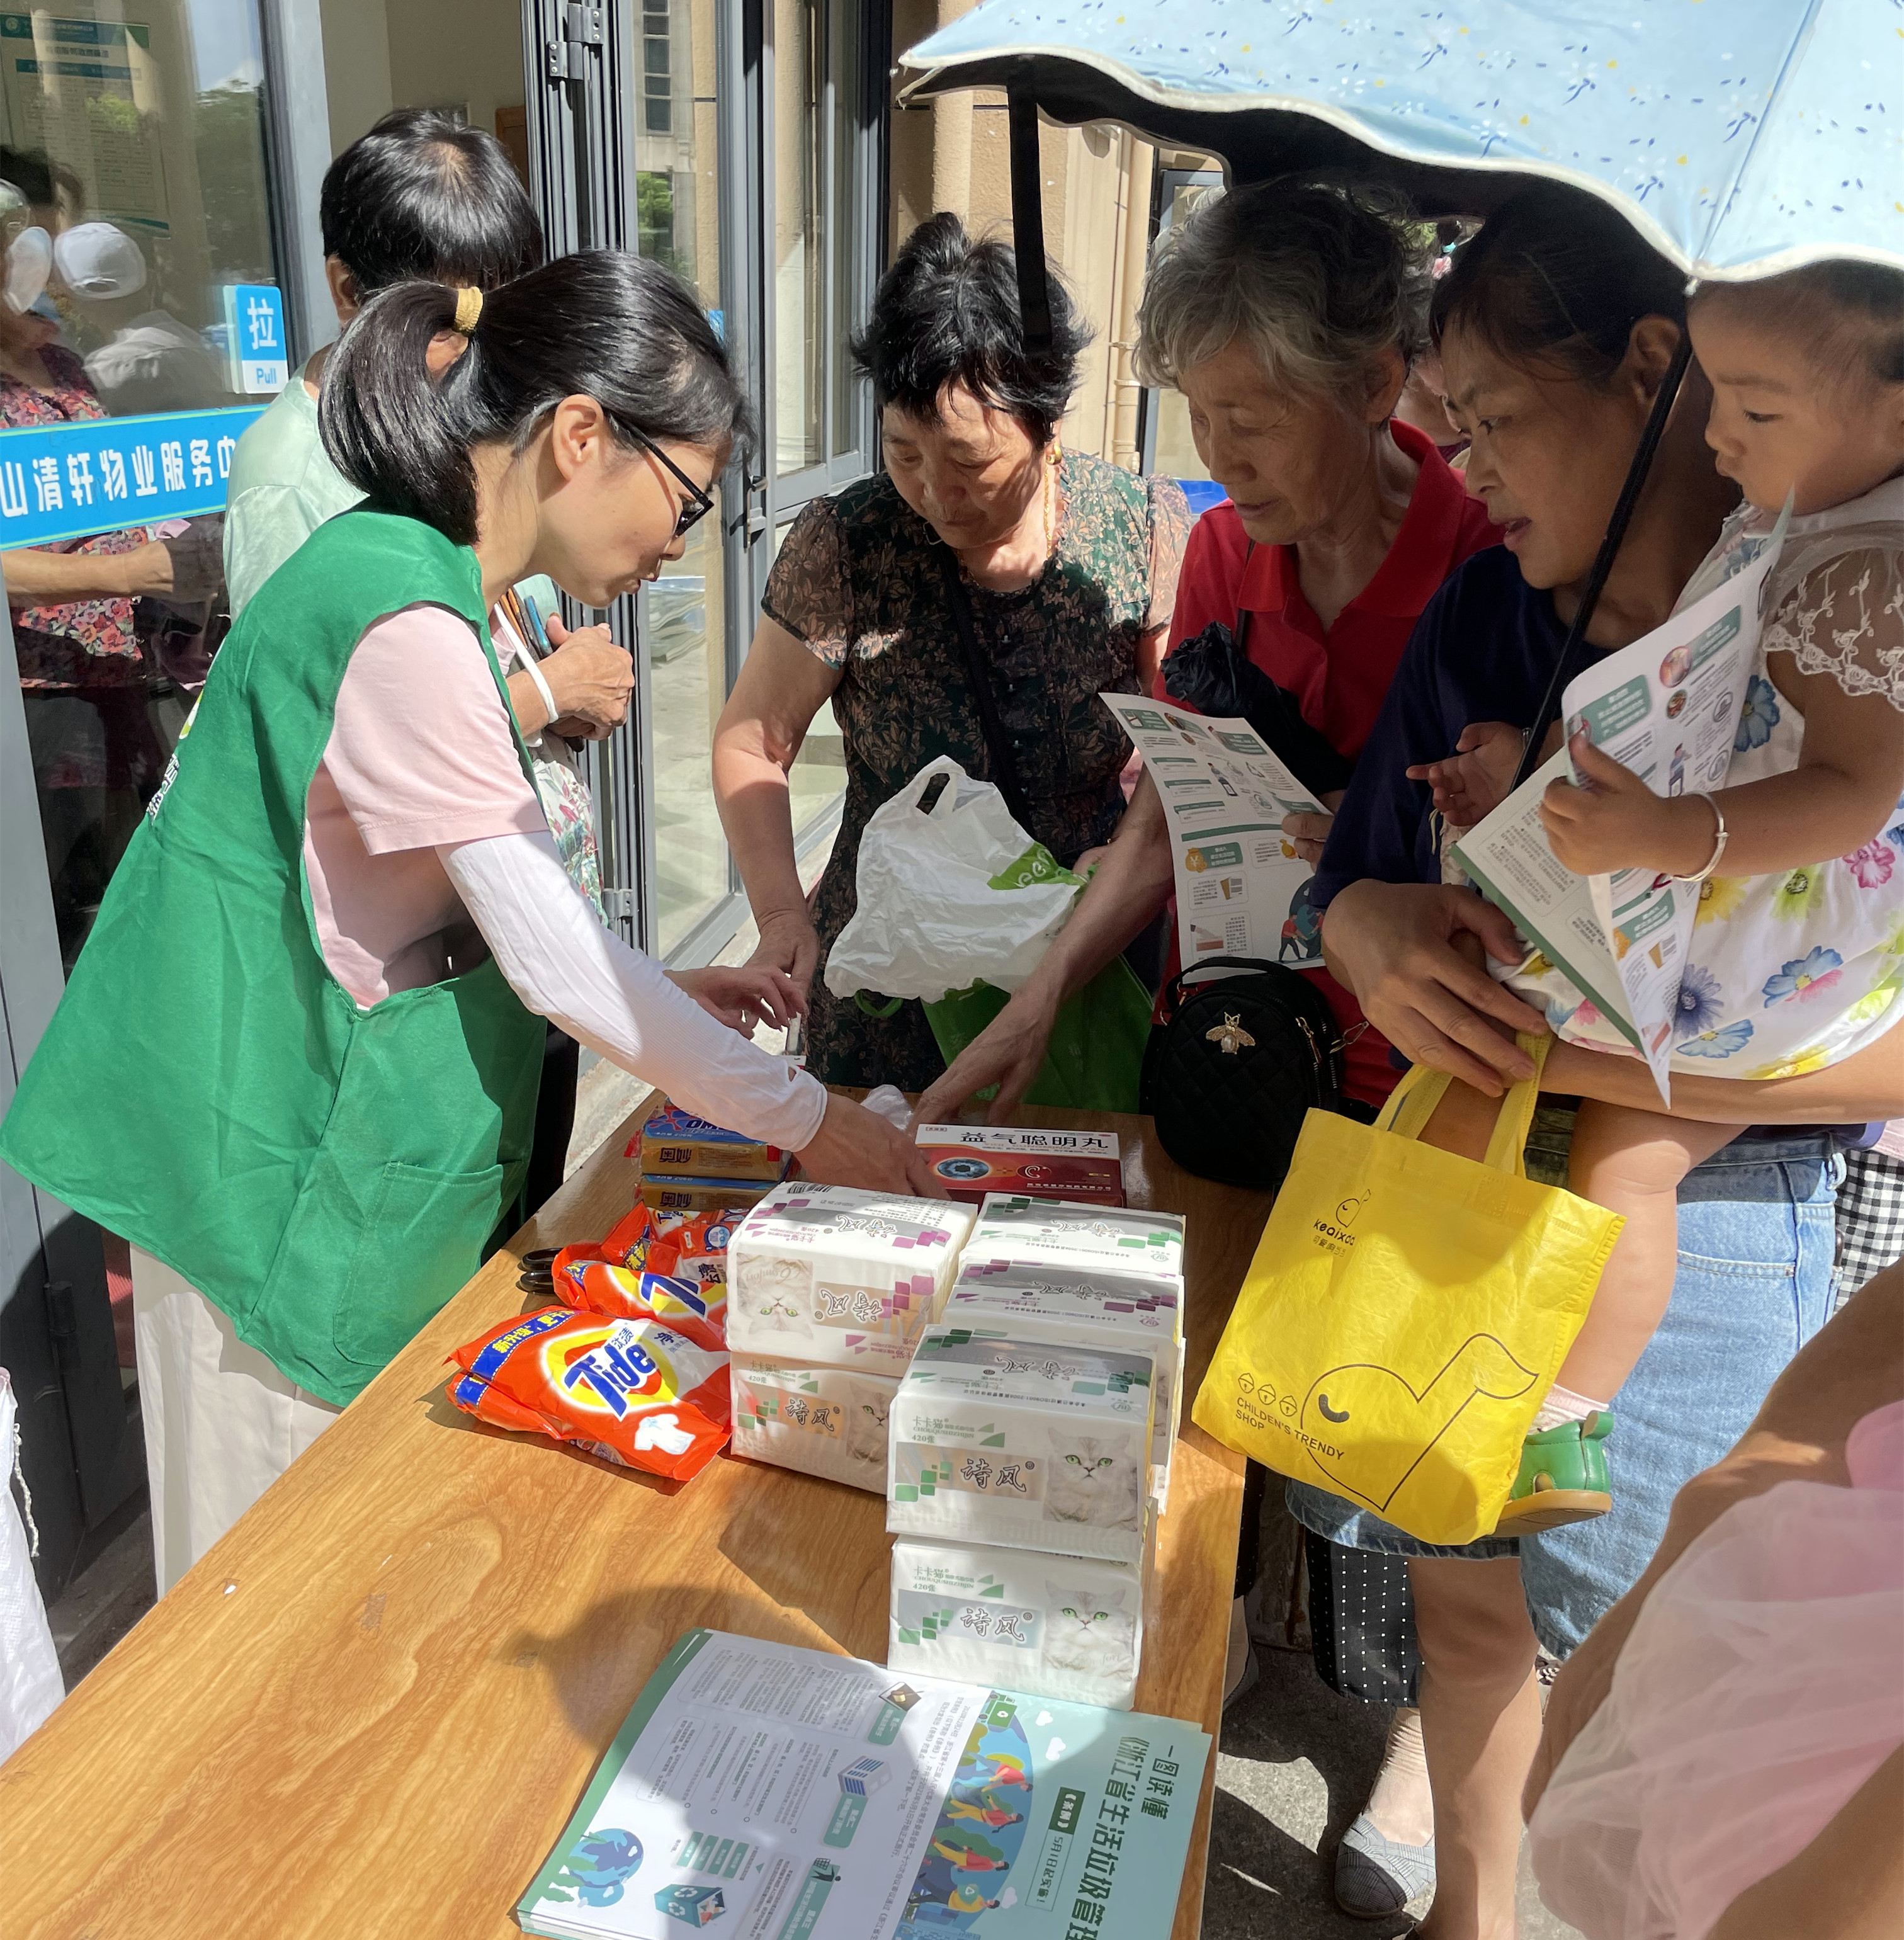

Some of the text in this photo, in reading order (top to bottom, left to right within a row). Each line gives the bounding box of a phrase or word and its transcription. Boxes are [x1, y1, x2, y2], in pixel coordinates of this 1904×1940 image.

[247, 297, 278, 350] 拉
[256, 368, 277, 384] Pull
[960, 1132, 1108, 1149] 益气聪明丸
[659, 1147, 692, 1163] 奥妙
[659, 1192, 692, 1208] 奥妙
[820, 1289, 882, 1322] 诗风
[613, 1327, 634, 1349] 汰渍
[564, 1343, 656, 1417] Tide
[748, 1375, 768, 1384] 420张
[785, 1398, 835, 1432] 诗风
[1235, 1409, 1265, 1430] SHOP
[912, 1434, 936, 1444] 420张
[1237, 1397, 1345, 1460] CHILDEN'S TRENDY
[960, 1458, 1027, 1492] 诗风
[912, 1584, 936, 1592] 420张
[960, 1608, 1025, 1642] 诗风
[1140, 1745, 1180, 1820] 一图读懂
